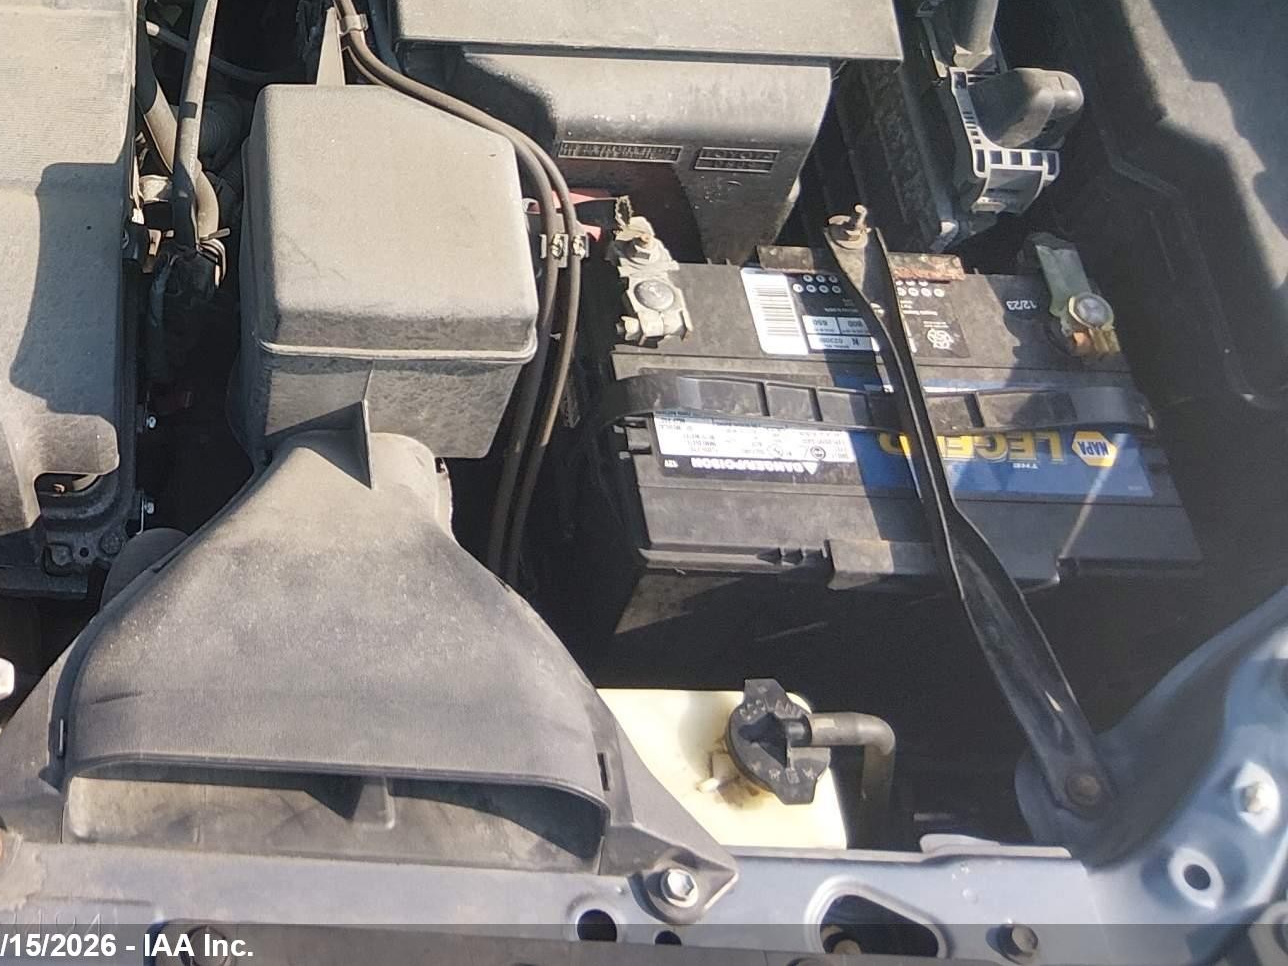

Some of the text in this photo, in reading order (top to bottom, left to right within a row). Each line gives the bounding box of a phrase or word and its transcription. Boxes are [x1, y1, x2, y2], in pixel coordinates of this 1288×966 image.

[1006, 299, 1037, 311] 12/23
[877, 430, 1064, 463] LEGED
[1077, 440, 1109, 460] NAPA
[690, 457, 805, 474] DANGER/POISON
[1013, 462, 1038, 470] THE
